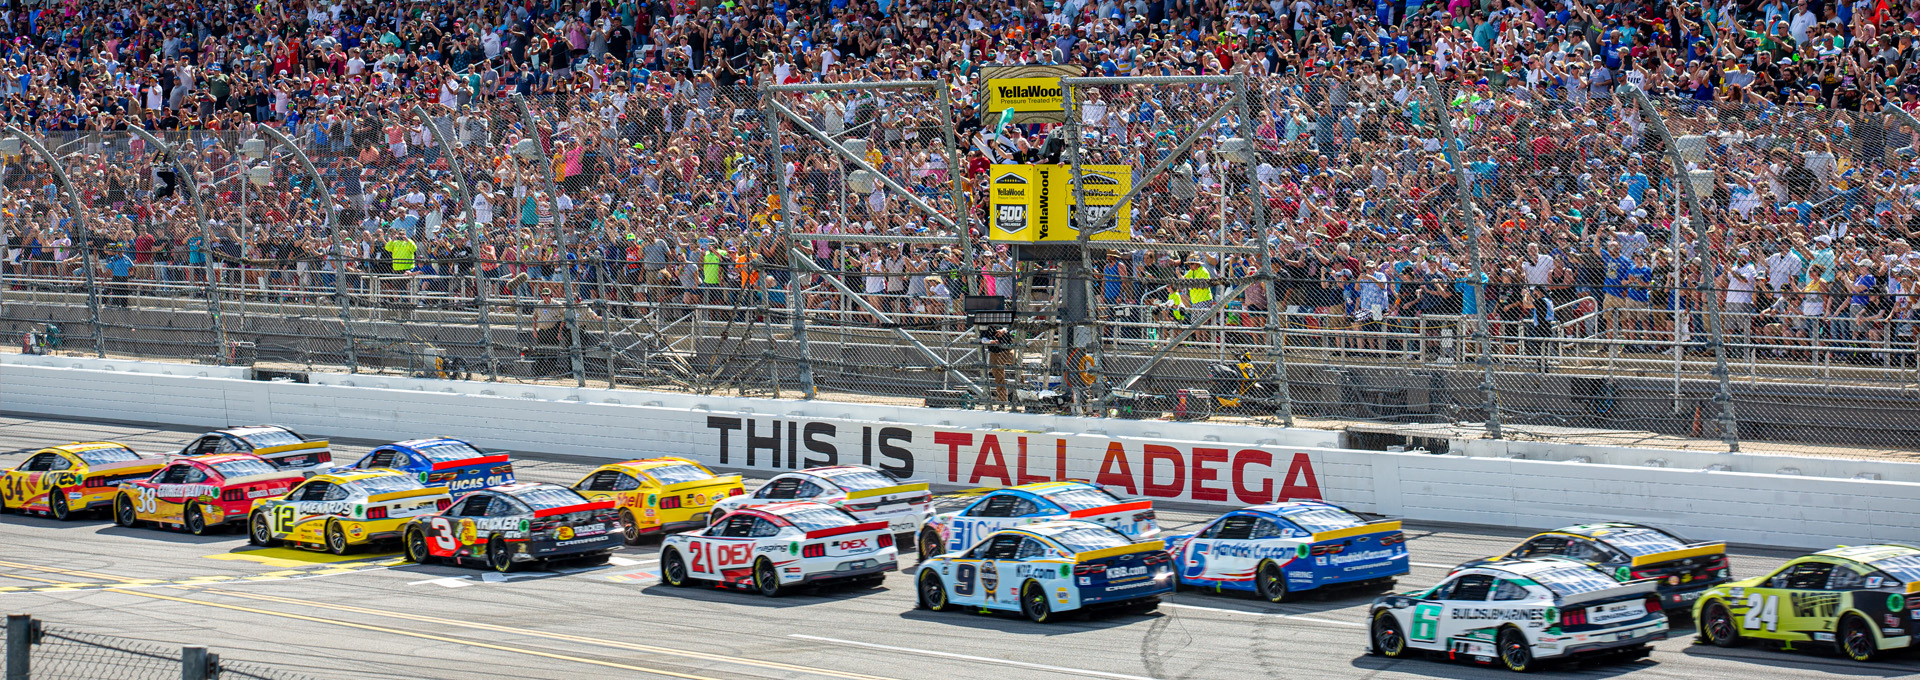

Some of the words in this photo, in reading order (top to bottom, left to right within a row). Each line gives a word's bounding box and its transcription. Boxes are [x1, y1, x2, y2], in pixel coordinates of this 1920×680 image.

[997, 188, 1024, 196] YellaWood
[1000, 206, 1023, 222] 500
[1040, 170, 1049, 239] YellaWood
[707, 416, 838, 469] THIS
[863, 426, 914, 478] IS
[934, 431, 1323, 505] TALLADEGA
[4, 475, 24, 501] 34
[446, 478, 484, 491] LUCAS
[486, 476, 502, 486] OIL
[136, 486, 156, 514] 38
[300, 502, 352, 516] MENARDS
[616, 492, 644, 508] Shell
[274, 505, 295, 534] 12
[477, 517, 520, 530] TRACKER
[890, 522, 916, 532] OYOTA
[431, 517, 456, 550] 3
[556, 536, 609, 546] CAMARO
[949, 518, 974, 554] 31
[840, 538, 868, 550] DEX
[690, 541, 714, 574] 21
[718, 543, 756, 566] DEX
[1184, 543, 1210, 577] 5
[1106, 566, 1148, 579] KBB.com
[1344, 560, 1393, 572] CAMARO
[954, 563, 976, 596] 9
[1105, 580, 1157, 592] CAMARO
[1452, 608, 1544, 620] BUILDSUBMARINES
[1744, 593, 1778, 632] 24
[1410, 604, 1443, 641] 6
